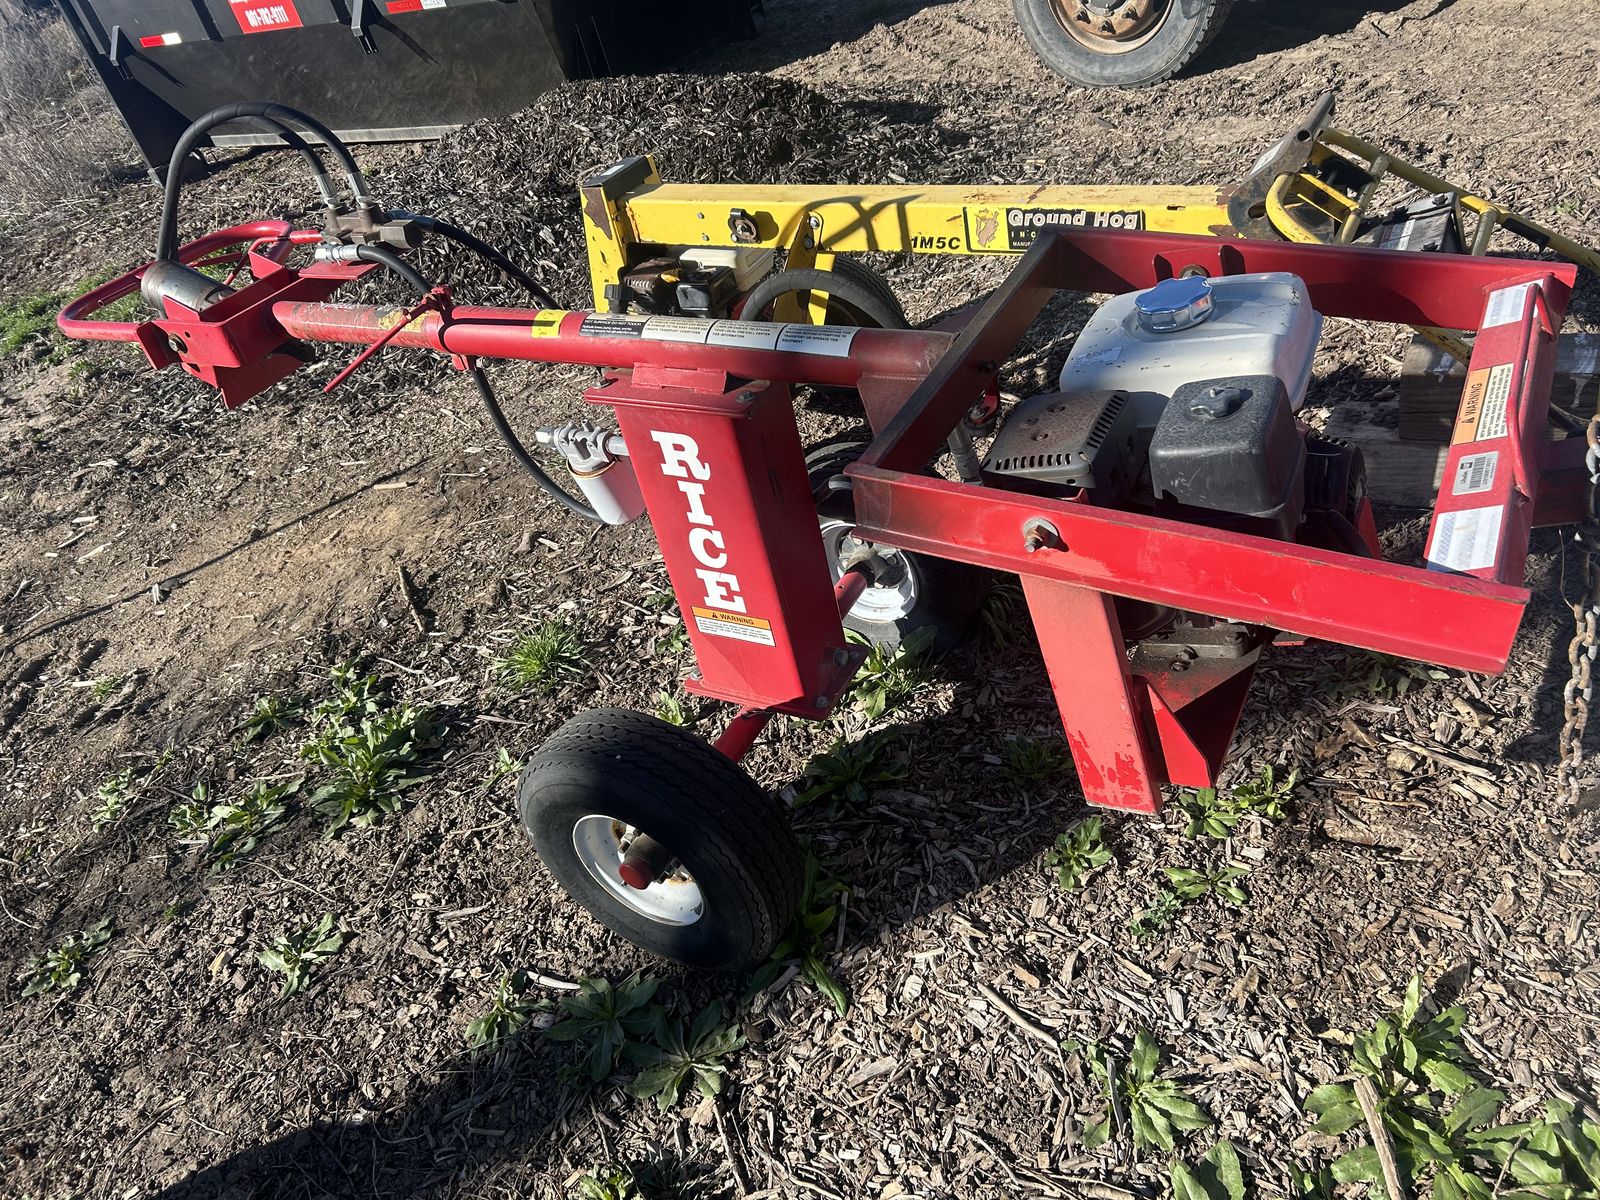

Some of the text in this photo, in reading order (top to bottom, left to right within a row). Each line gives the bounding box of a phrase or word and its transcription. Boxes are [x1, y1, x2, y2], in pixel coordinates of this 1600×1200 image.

[1008, 209, 1139, 230] Ground Hog
[1464, 383, 1483, 416] WARNING
[650, 430, 747, 613] RICE
[720, 613, 754, 625] WARNING
